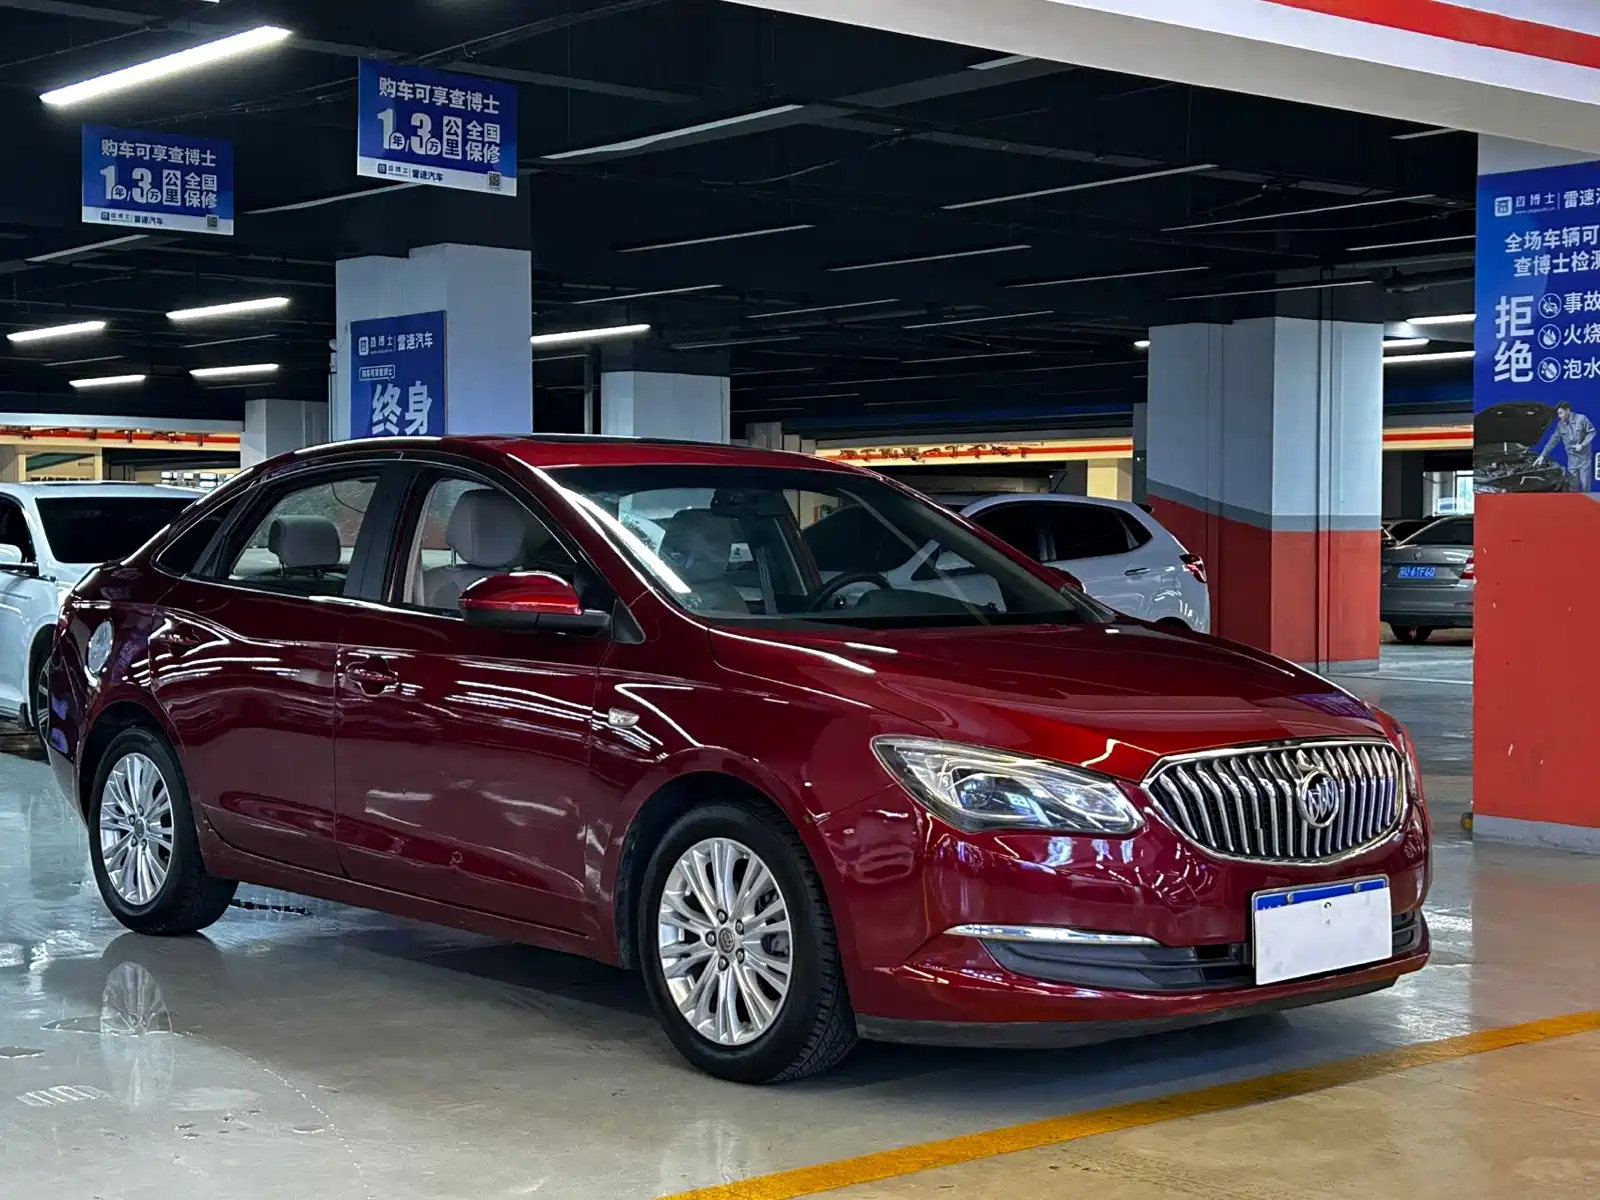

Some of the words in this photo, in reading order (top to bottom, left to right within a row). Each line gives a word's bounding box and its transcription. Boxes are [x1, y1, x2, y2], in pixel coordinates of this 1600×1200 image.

[379, 77, 499, 114] 购车可享查博士
[101, 139, 216, 166] 购车可享查博士
[1504, 225, 1600, 253] 全场车辆可
[1563, 290, 1600, 314] 事故
[398, 332, 433, 351] 雷速汽车
[1494, 295, 1535, 382] 拒绝
[1563, 356, 1600, 379] 泡水
[372, 381, 433, 436] 终身
